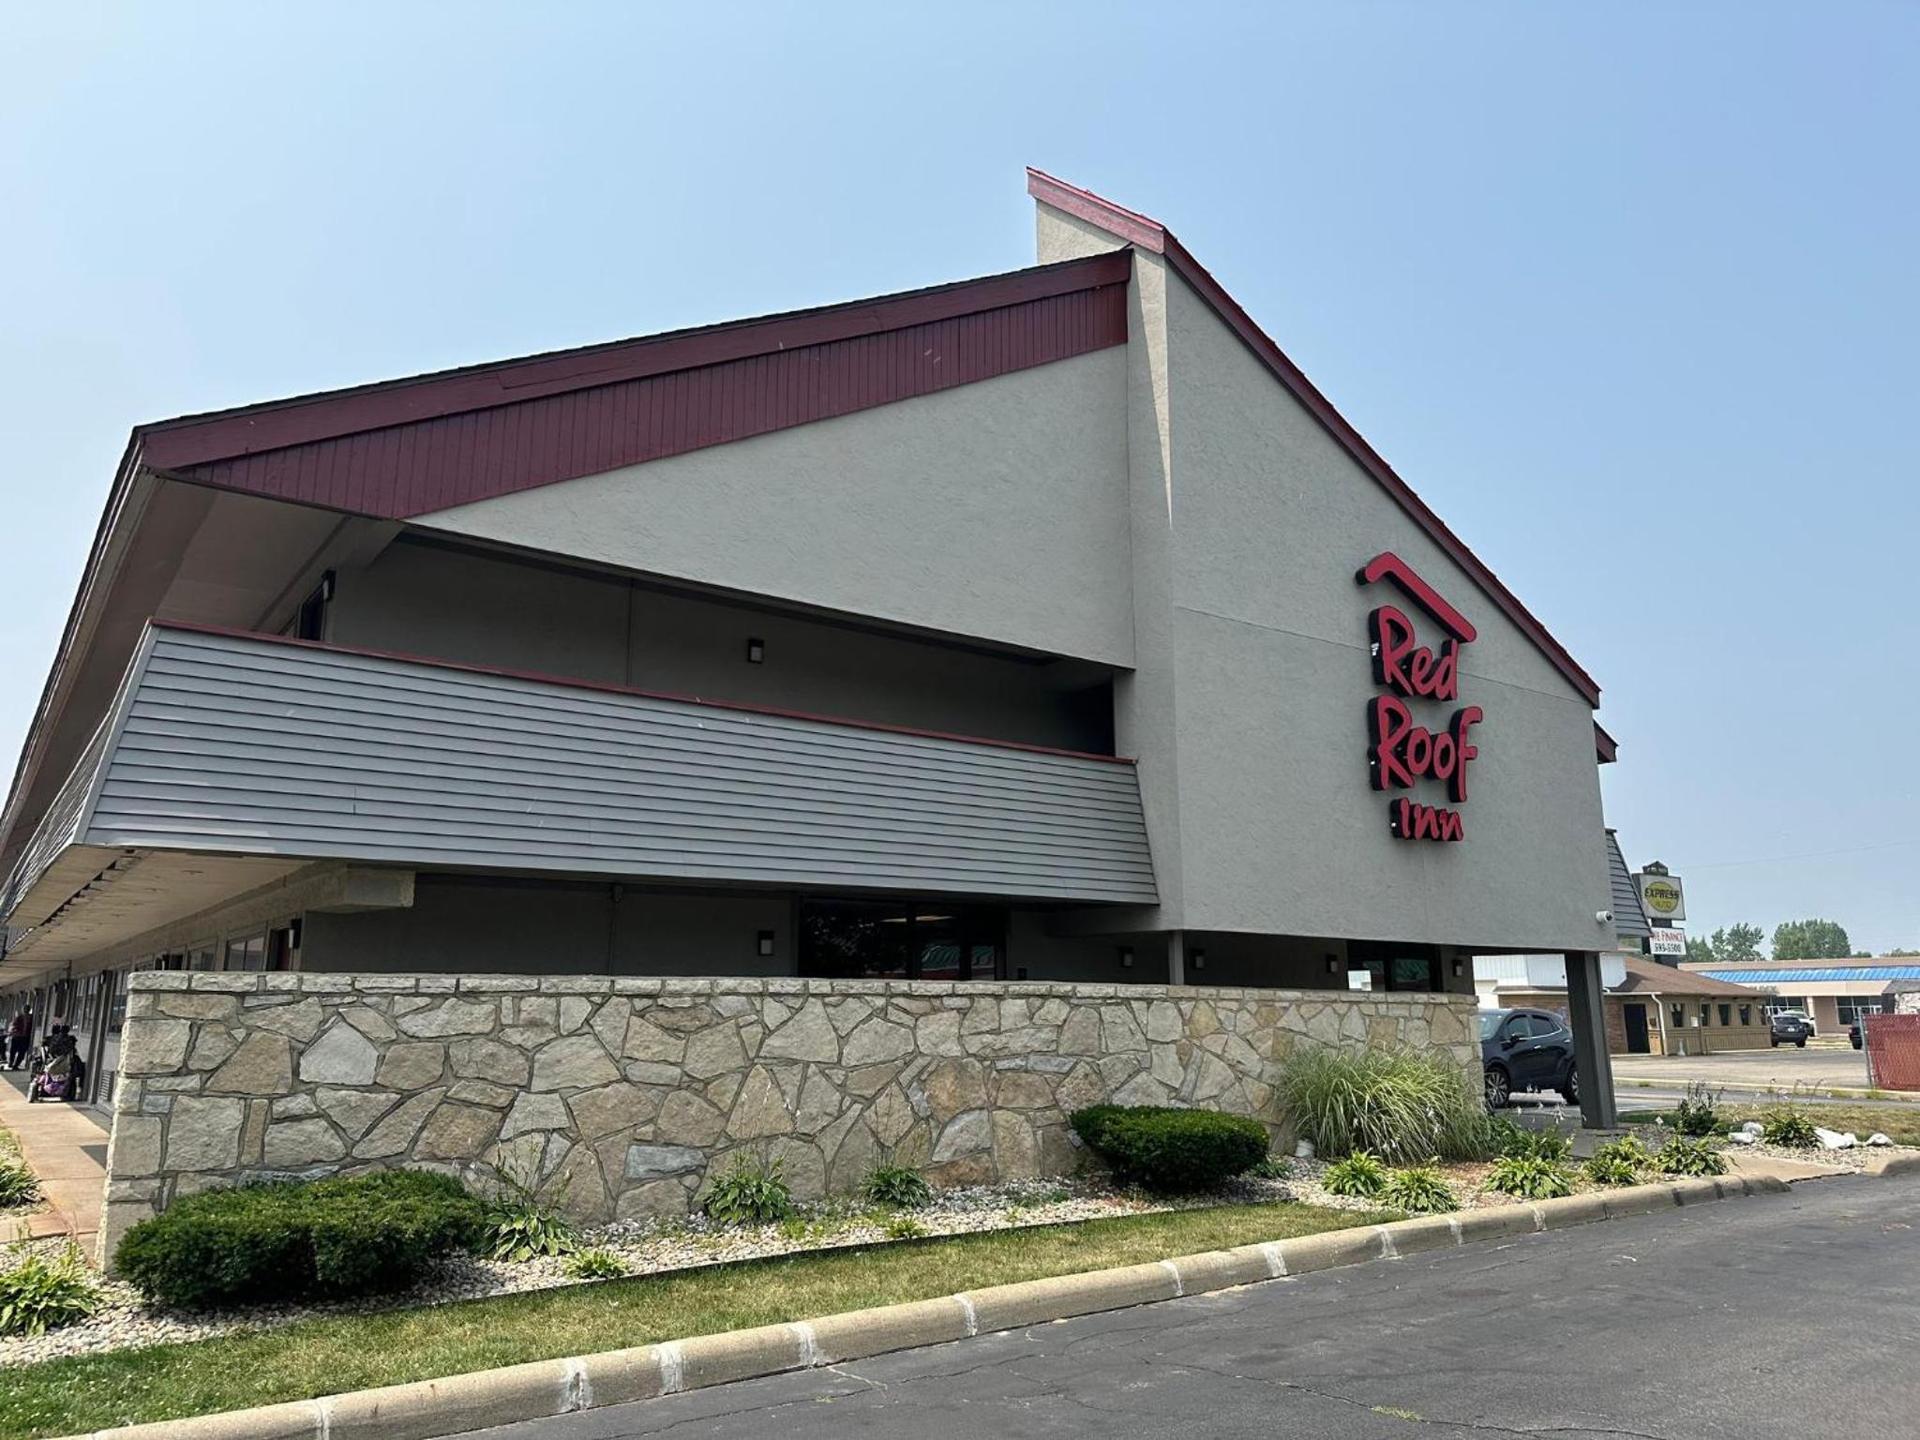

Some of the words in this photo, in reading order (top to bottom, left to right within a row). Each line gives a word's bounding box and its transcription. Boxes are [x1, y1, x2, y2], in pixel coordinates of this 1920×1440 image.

[1369, 605, 1459, 701] Red
[1367, 694, 1483, 802] Roof
[1390, 797, 1464, 842] Inn
[1644, 887, 1680, 899] EXPRESS
[1661, 931, 1683, 942] FINANCE
